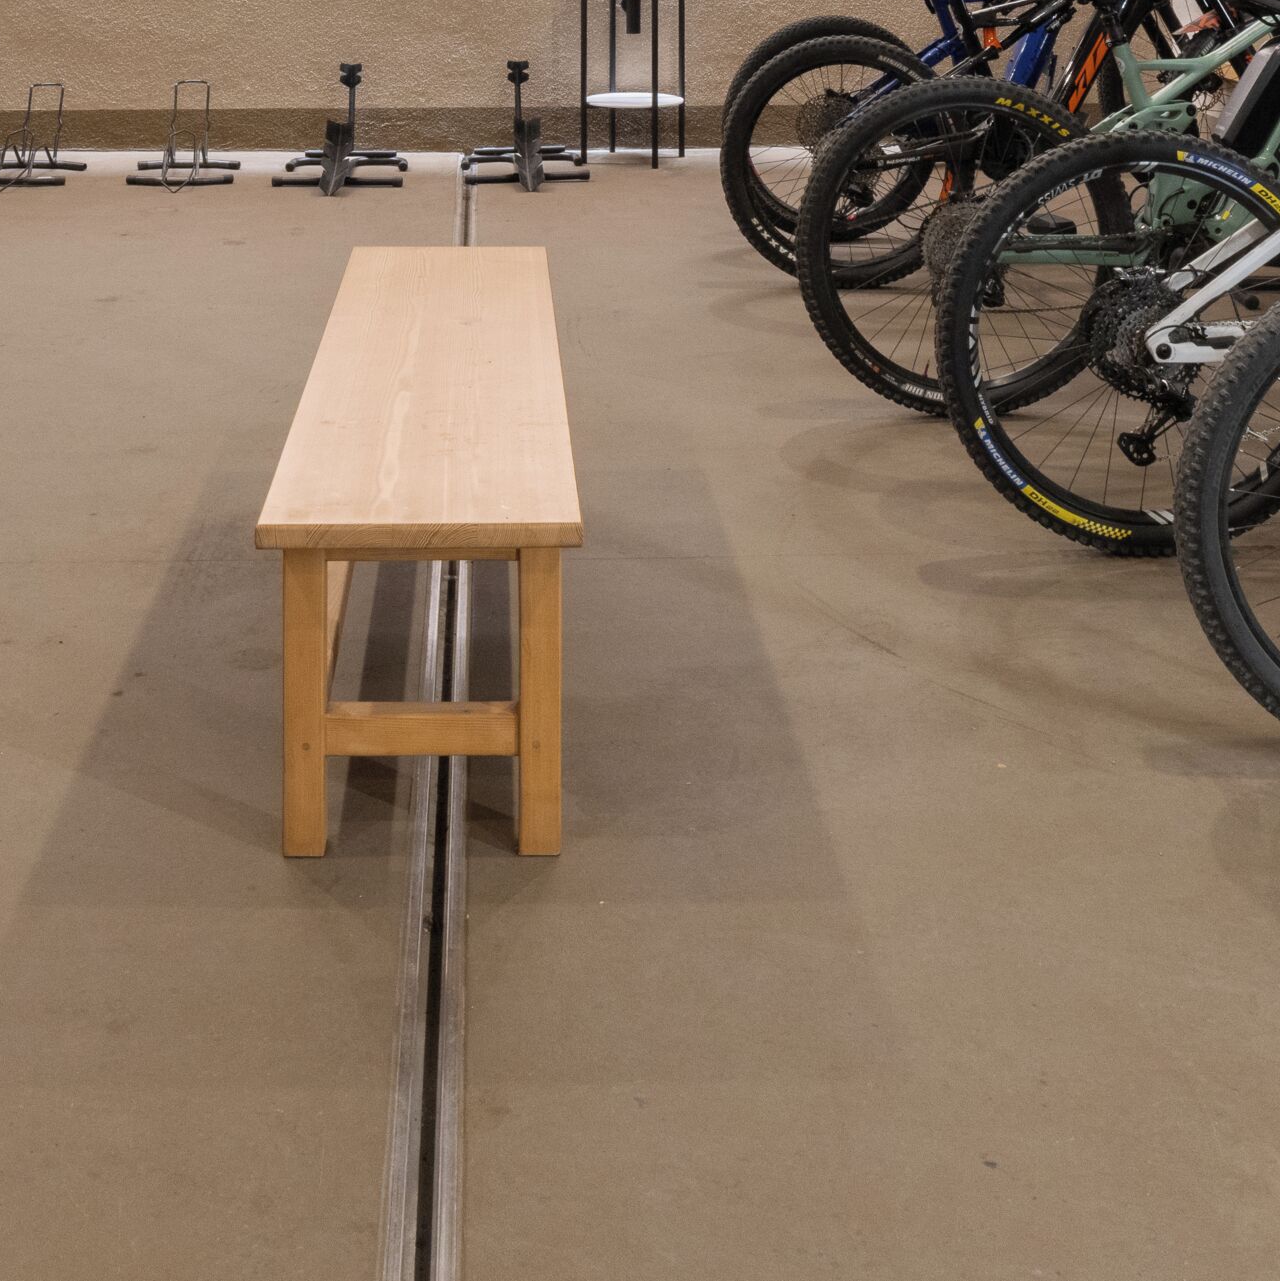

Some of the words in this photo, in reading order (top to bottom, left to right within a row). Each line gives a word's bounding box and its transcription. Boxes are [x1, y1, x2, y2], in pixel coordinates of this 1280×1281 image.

[995, 97, 1070, 137] MAXXIS
[1196, 158, 1253, 186] MICHELIN
[985, 437, 1024, 487] MICHELIN
